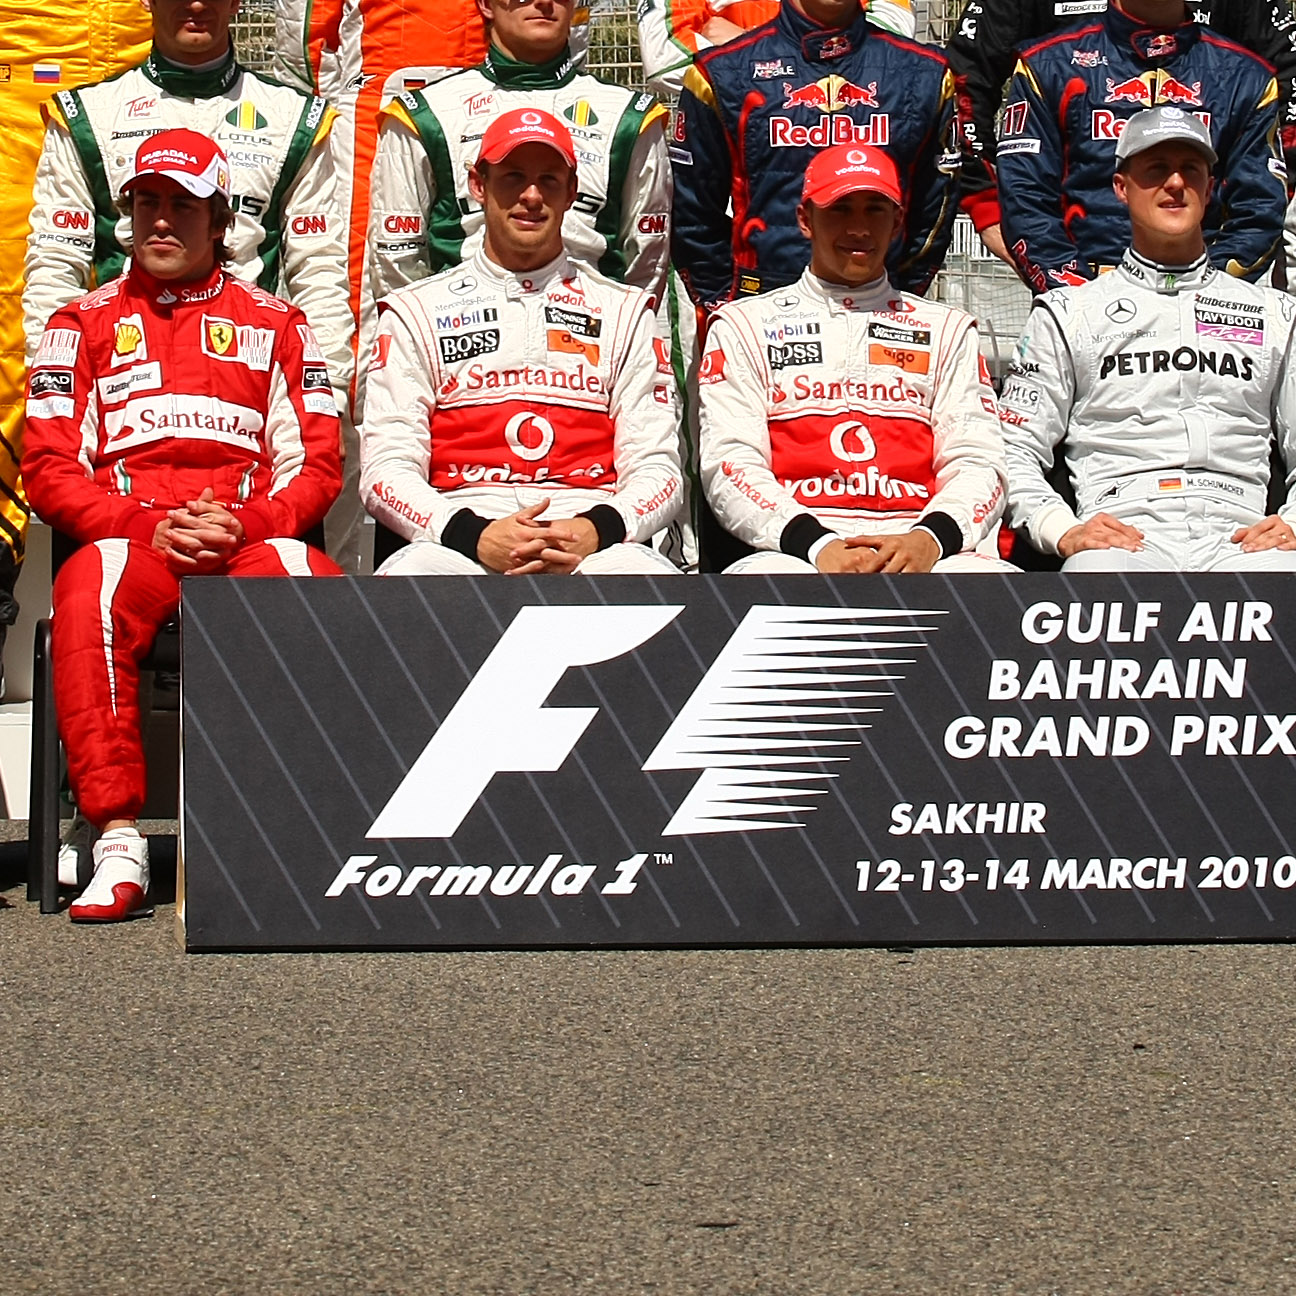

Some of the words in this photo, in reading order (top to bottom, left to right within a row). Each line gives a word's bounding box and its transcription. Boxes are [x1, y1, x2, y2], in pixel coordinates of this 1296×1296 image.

[464, 93, 496, 112] Tune
[509, 125, 555, 137] vodafone
[770, 114, 831, 147] Red
[833, 113, 890, 146] Bull
[1092, 109, 1126, 141] Re
[218, 133, 272, 146] LOTUS
[574, 150, 603, 165] CKETT
[835, 164, 880, 176] vodafone
[54, 211, 89, 230] CNN
[292, 215, 326, 234] CNN
[385, 215, 421, 233] CNN
[638, 215, 666, 233] CNN
[38, 234, 93, 249] PROTON
[181, 275, 225, 303] Santan
[437, 311, 481, 330] Mobil
[1196, 310, 1261, 328] NAVYBOOT
[442, 331, 498, 355] BOSS
[764, 325, 803, 341] Mobil
[770, 343, 820, 364] BOSS
[1101, 346, 1253, 381] PETRONAS
[467, 364, 605, 395] Santander
[793, 375, 926, 406] Santander
[140, 407, 256, 441] Santander
[784, 467, 930, 499] vodafone
[381, 484, 432, 529] Santand
[1021, 601, 1161, 644] GULF
[1178, 601, 1274, 643] AIR
[988, 657, 1247, 701] BAHRAIN
[943, 715, 1151, 759] GRAND
[888, 802, 1047, 835] SAKHIR
[324, 854, 599, 897] Formula
[600, 853, 649, 895] 1
[855, 858, 1030, 892] 12-13-14
[1041, 857, 1186, 891] MARCH
